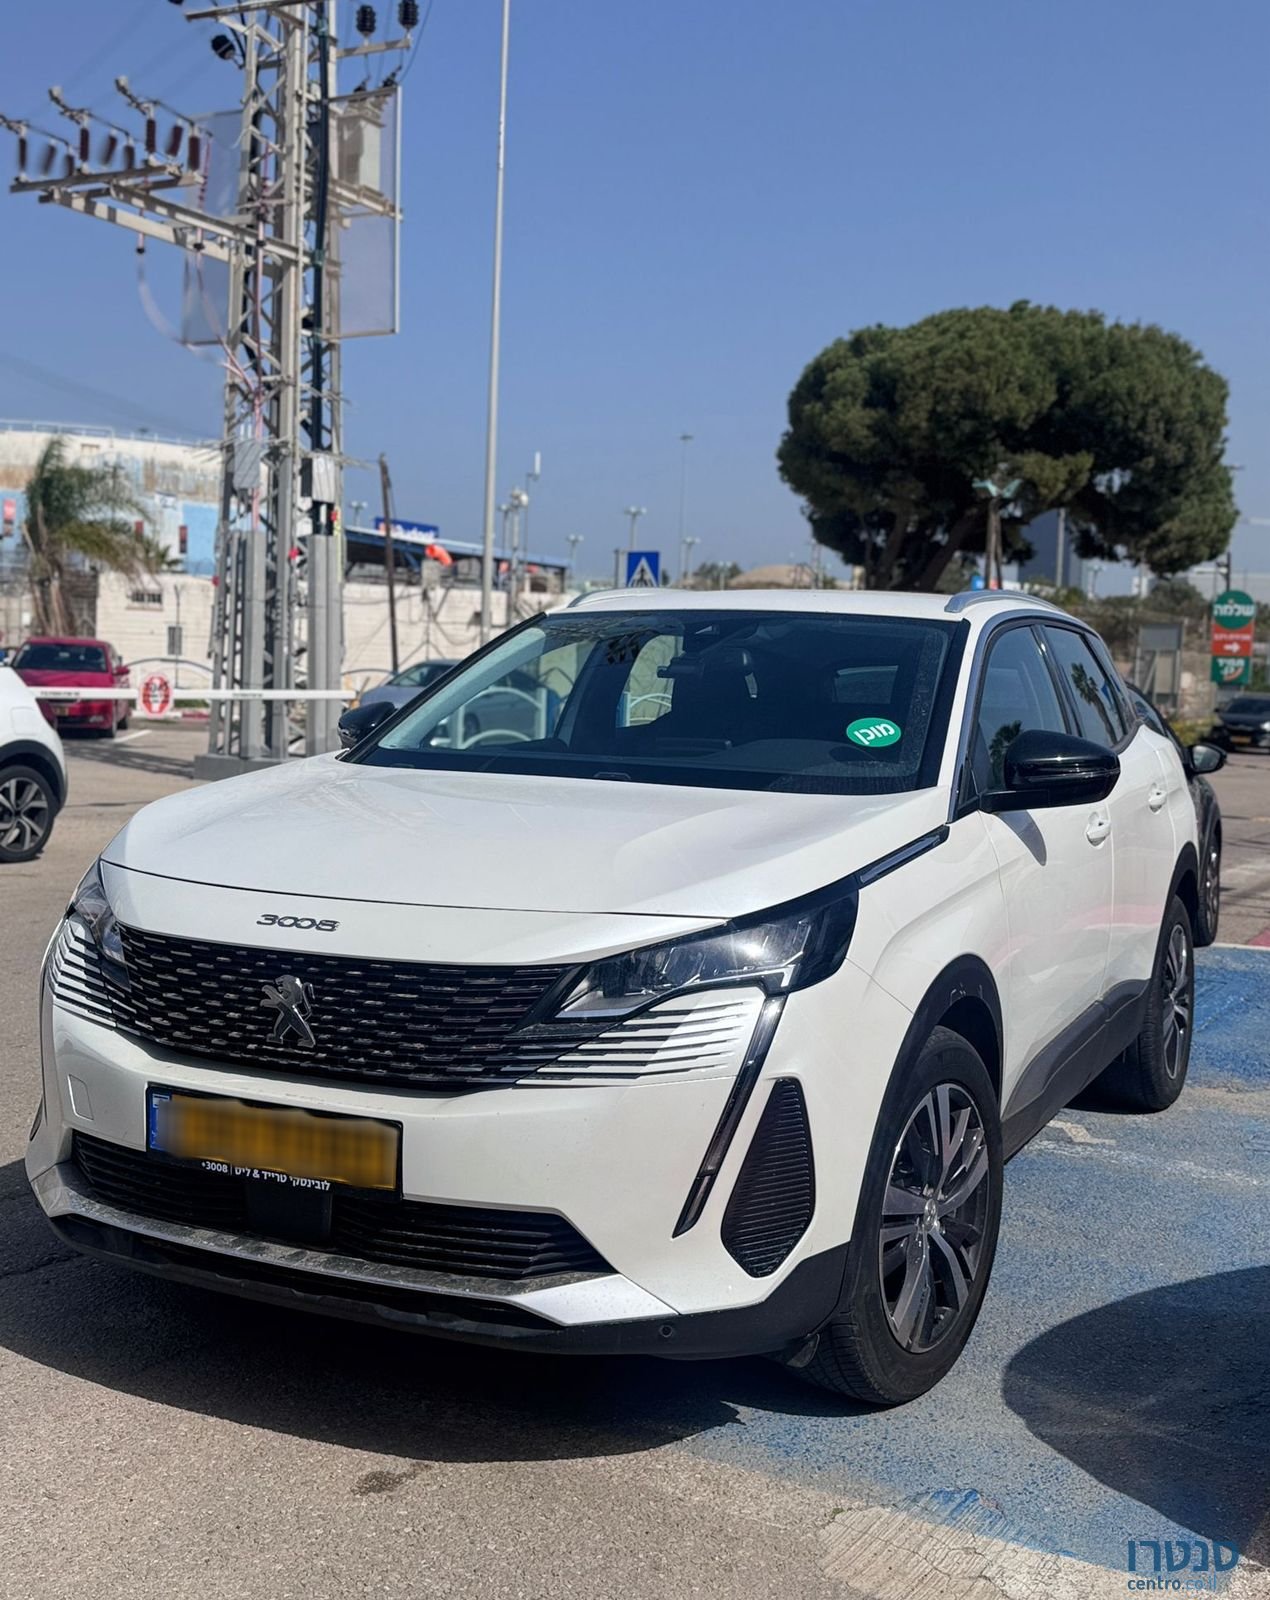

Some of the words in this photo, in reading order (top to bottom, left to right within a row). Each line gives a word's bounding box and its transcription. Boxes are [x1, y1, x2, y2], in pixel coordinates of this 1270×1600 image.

[1213, 599, 1255, 617] שלמה
[853, 723, 895, 745] מוכן
[256, 913, 340, 932] 3008
[252, 1168, 260, 1179] &
[261, 1170, 287, 1183] טרייד
[289, 1175, 331, 1191] לובינסקי
